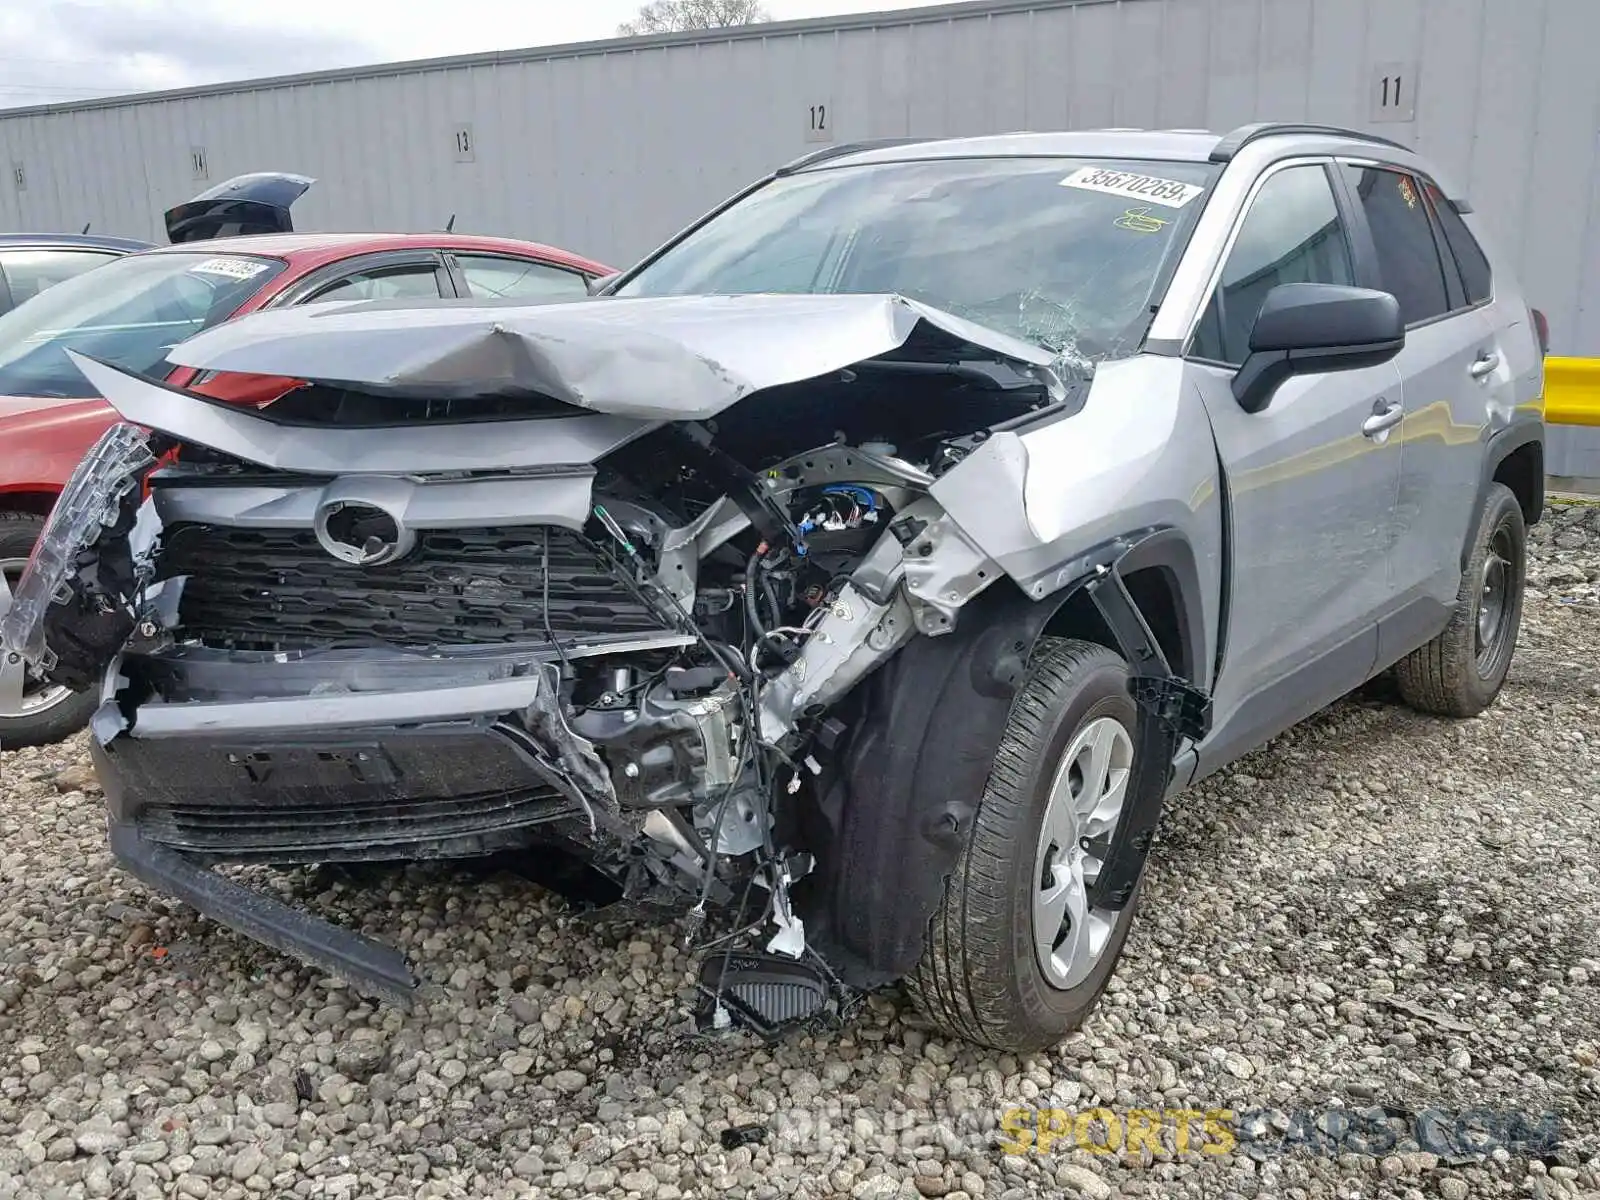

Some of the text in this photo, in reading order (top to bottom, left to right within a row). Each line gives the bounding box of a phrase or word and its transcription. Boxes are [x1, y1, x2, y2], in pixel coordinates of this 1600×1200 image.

[1382, 76, 1401, 106] 11
[810, 105, 825, 130] 12
[456, 132, 469, 152] 13
